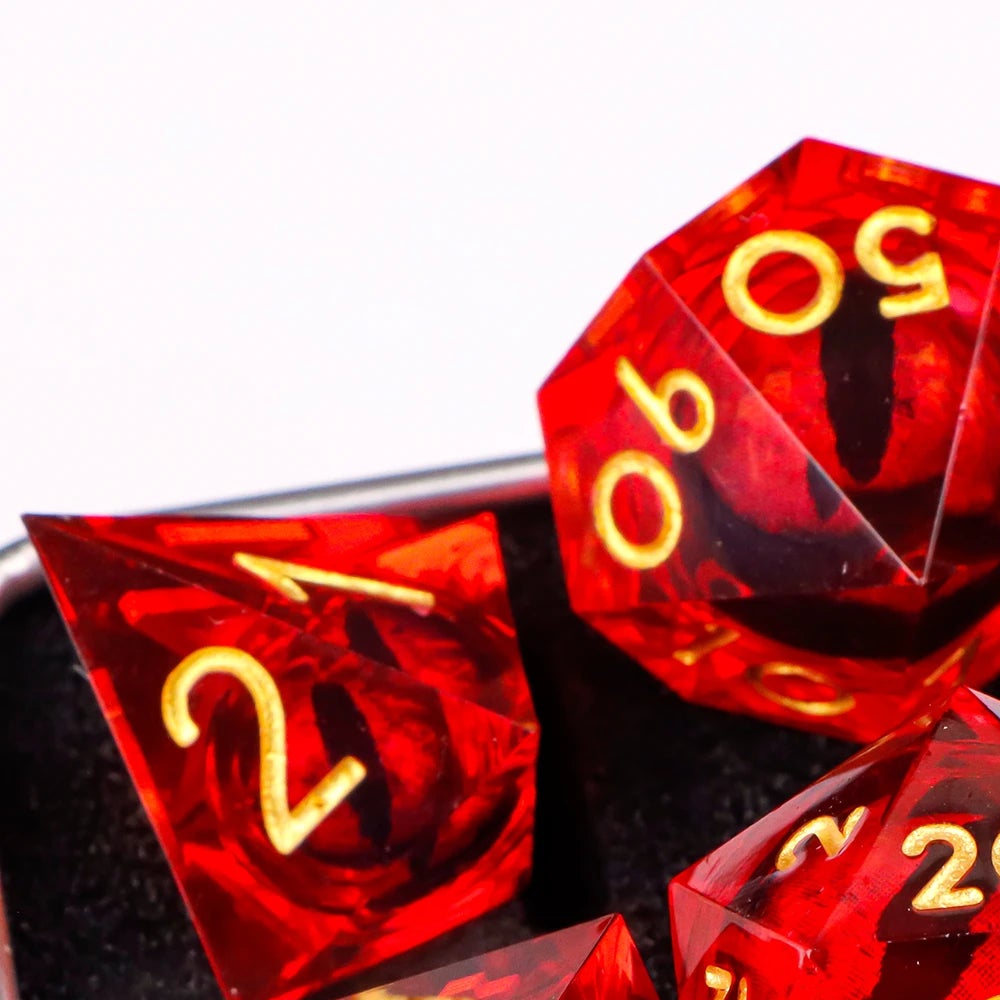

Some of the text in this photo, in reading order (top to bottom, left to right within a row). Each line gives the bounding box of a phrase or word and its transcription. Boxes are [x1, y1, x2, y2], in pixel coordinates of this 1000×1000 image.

[722, 206, 950, 335] 50
[161, 646, 367, 855] 2
[776, 806, 866, 871] 2
